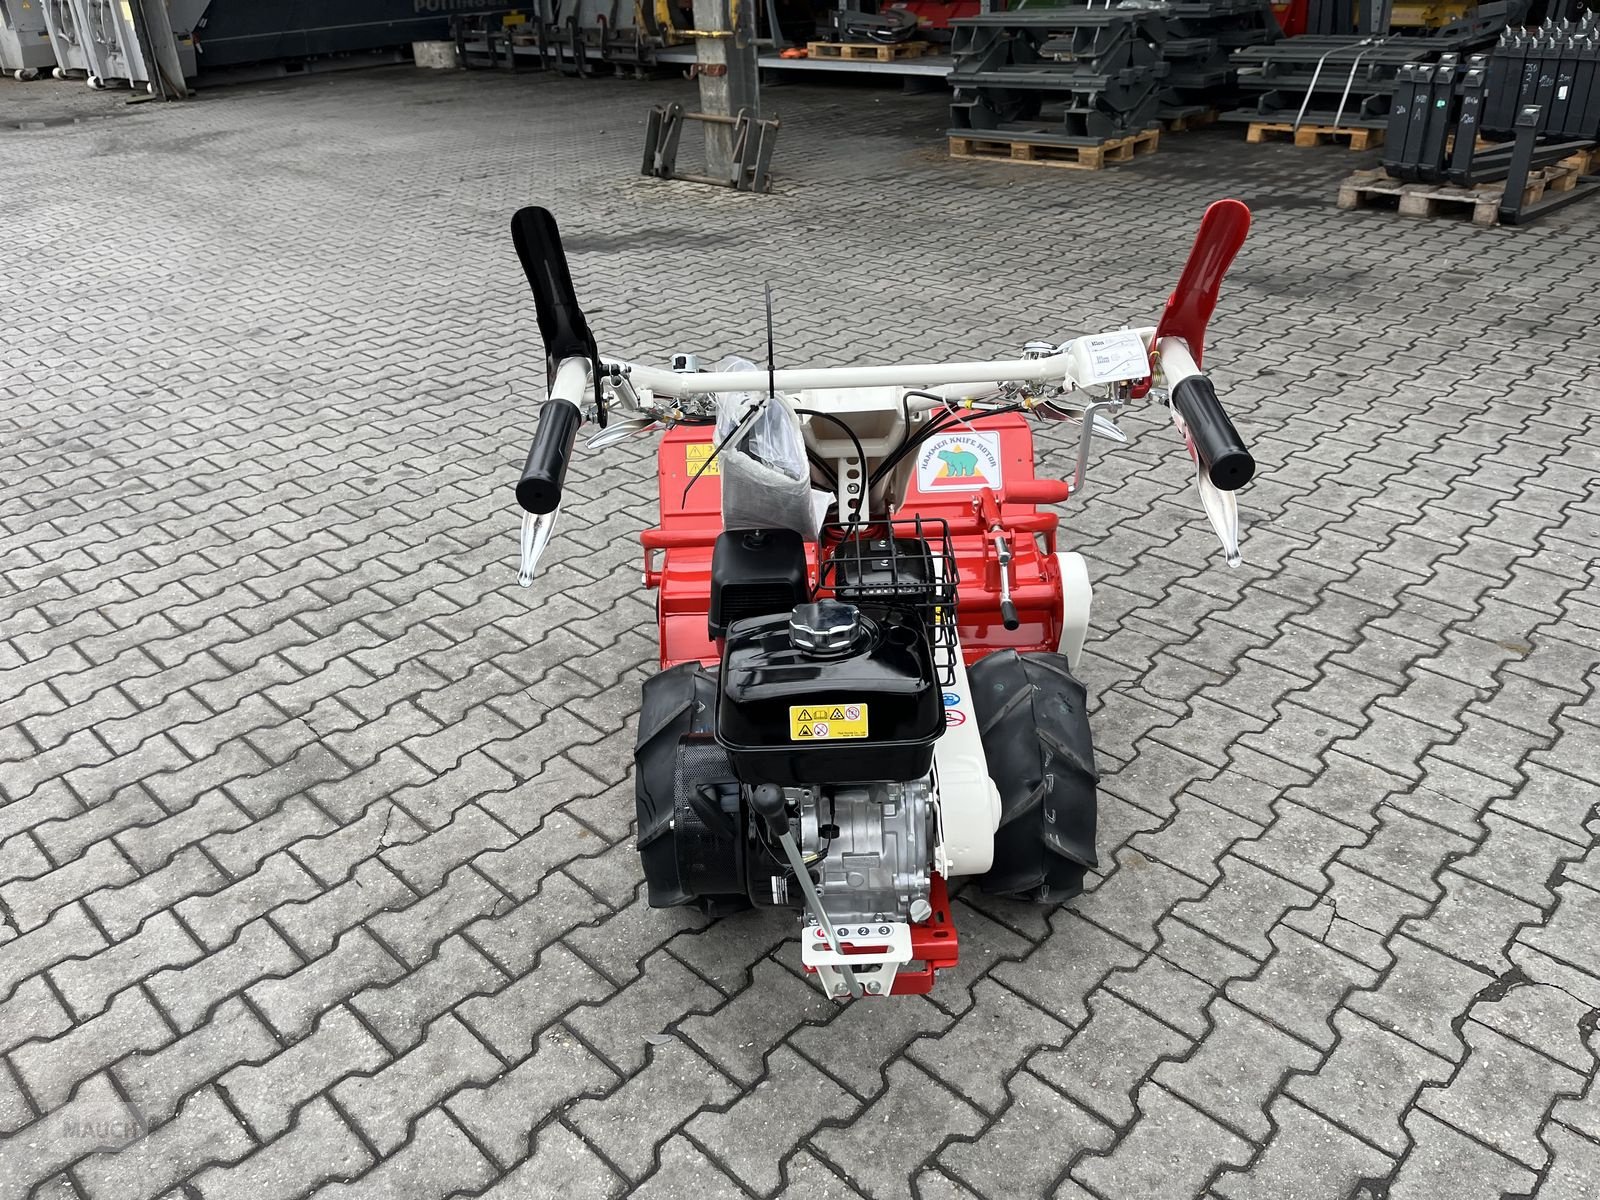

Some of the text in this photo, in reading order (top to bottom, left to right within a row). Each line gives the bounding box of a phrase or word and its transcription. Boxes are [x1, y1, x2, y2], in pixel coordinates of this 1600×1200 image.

[921, 436, 997, 470] HAMMER KNIFE ROTOR
